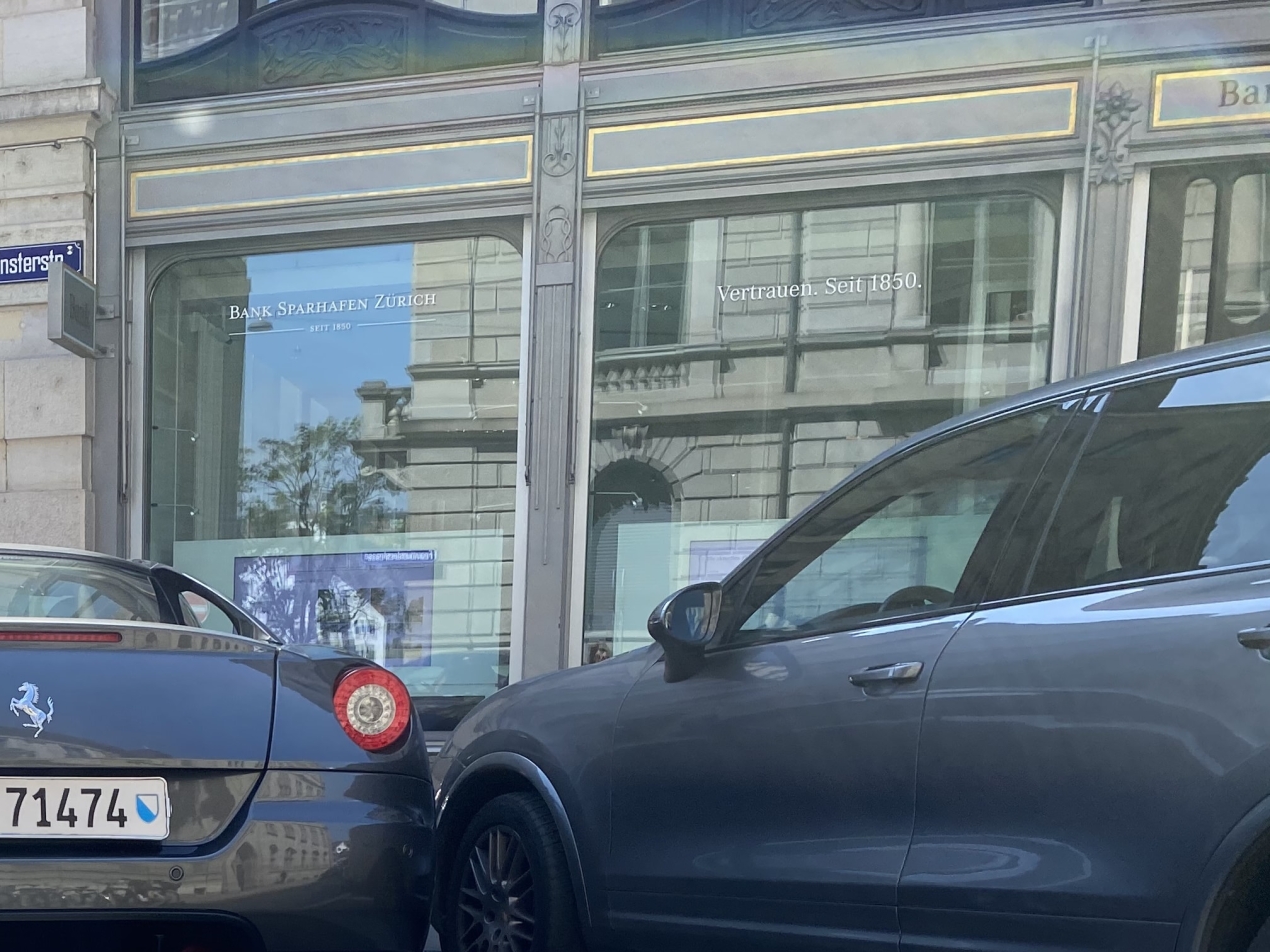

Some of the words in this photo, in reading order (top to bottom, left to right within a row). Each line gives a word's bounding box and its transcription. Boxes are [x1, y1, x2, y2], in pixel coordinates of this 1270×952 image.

[717, 282, 818, 302] Vertrauen.
[825, 276, 863, 295] Seit
[870, 272, 922, 292] 1850.
[332, 322, 351, 331] 1850
